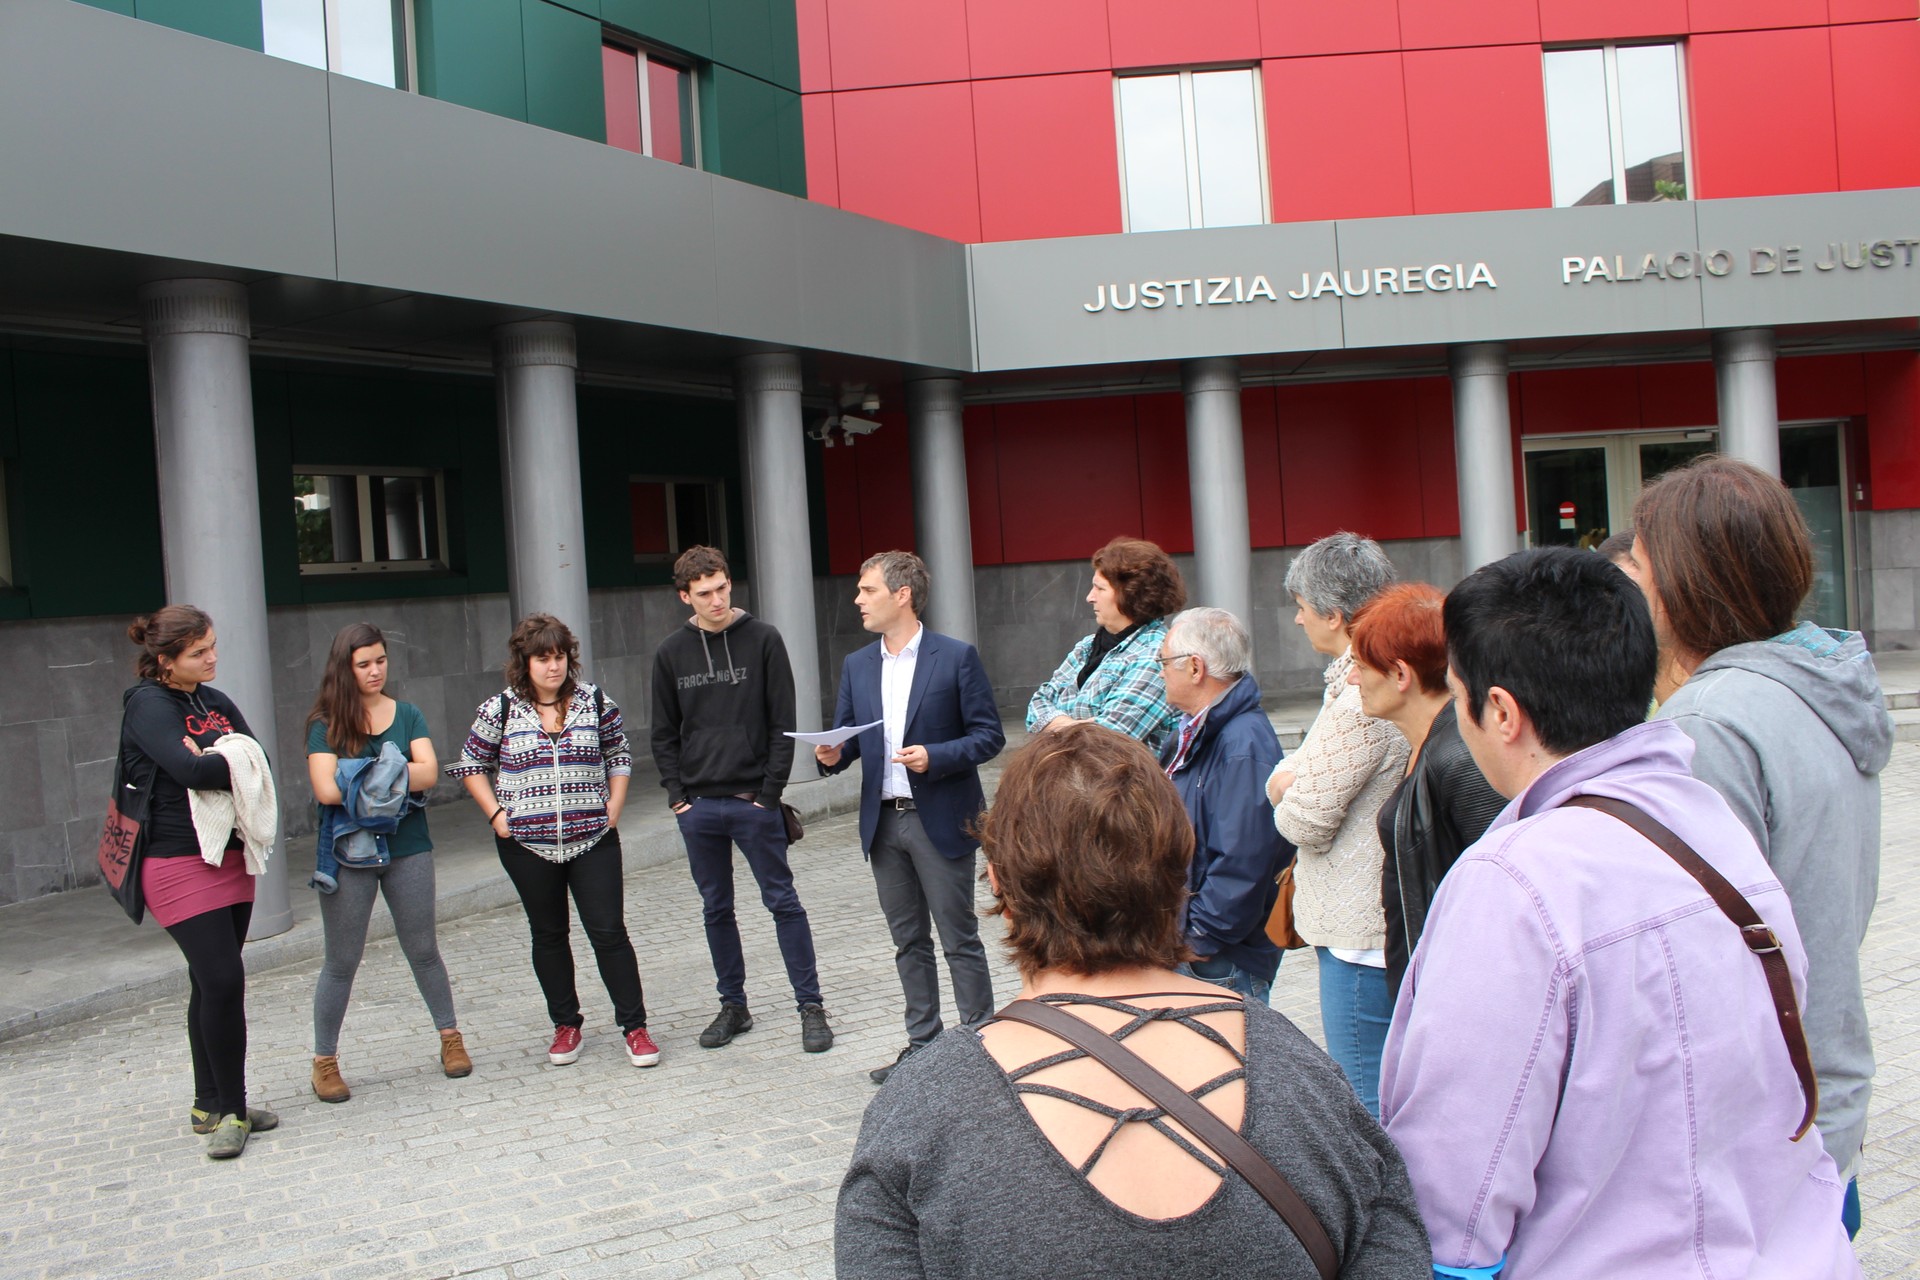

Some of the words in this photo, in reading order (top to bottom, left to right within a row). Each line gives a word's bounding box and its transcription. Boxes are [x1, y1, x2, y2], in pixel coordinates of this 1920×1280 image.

[1561, 249, 1734, 285] PALACIO
[1750, 245, 1804, 274] DE
[1815, 238, 1920, 271] JUST
[1083, 275, 1277, 313] JUSTIZIA
[1287, 262, 1497, 300] JAUREGIA
[677, 669, 730, 690] FRACKNG
